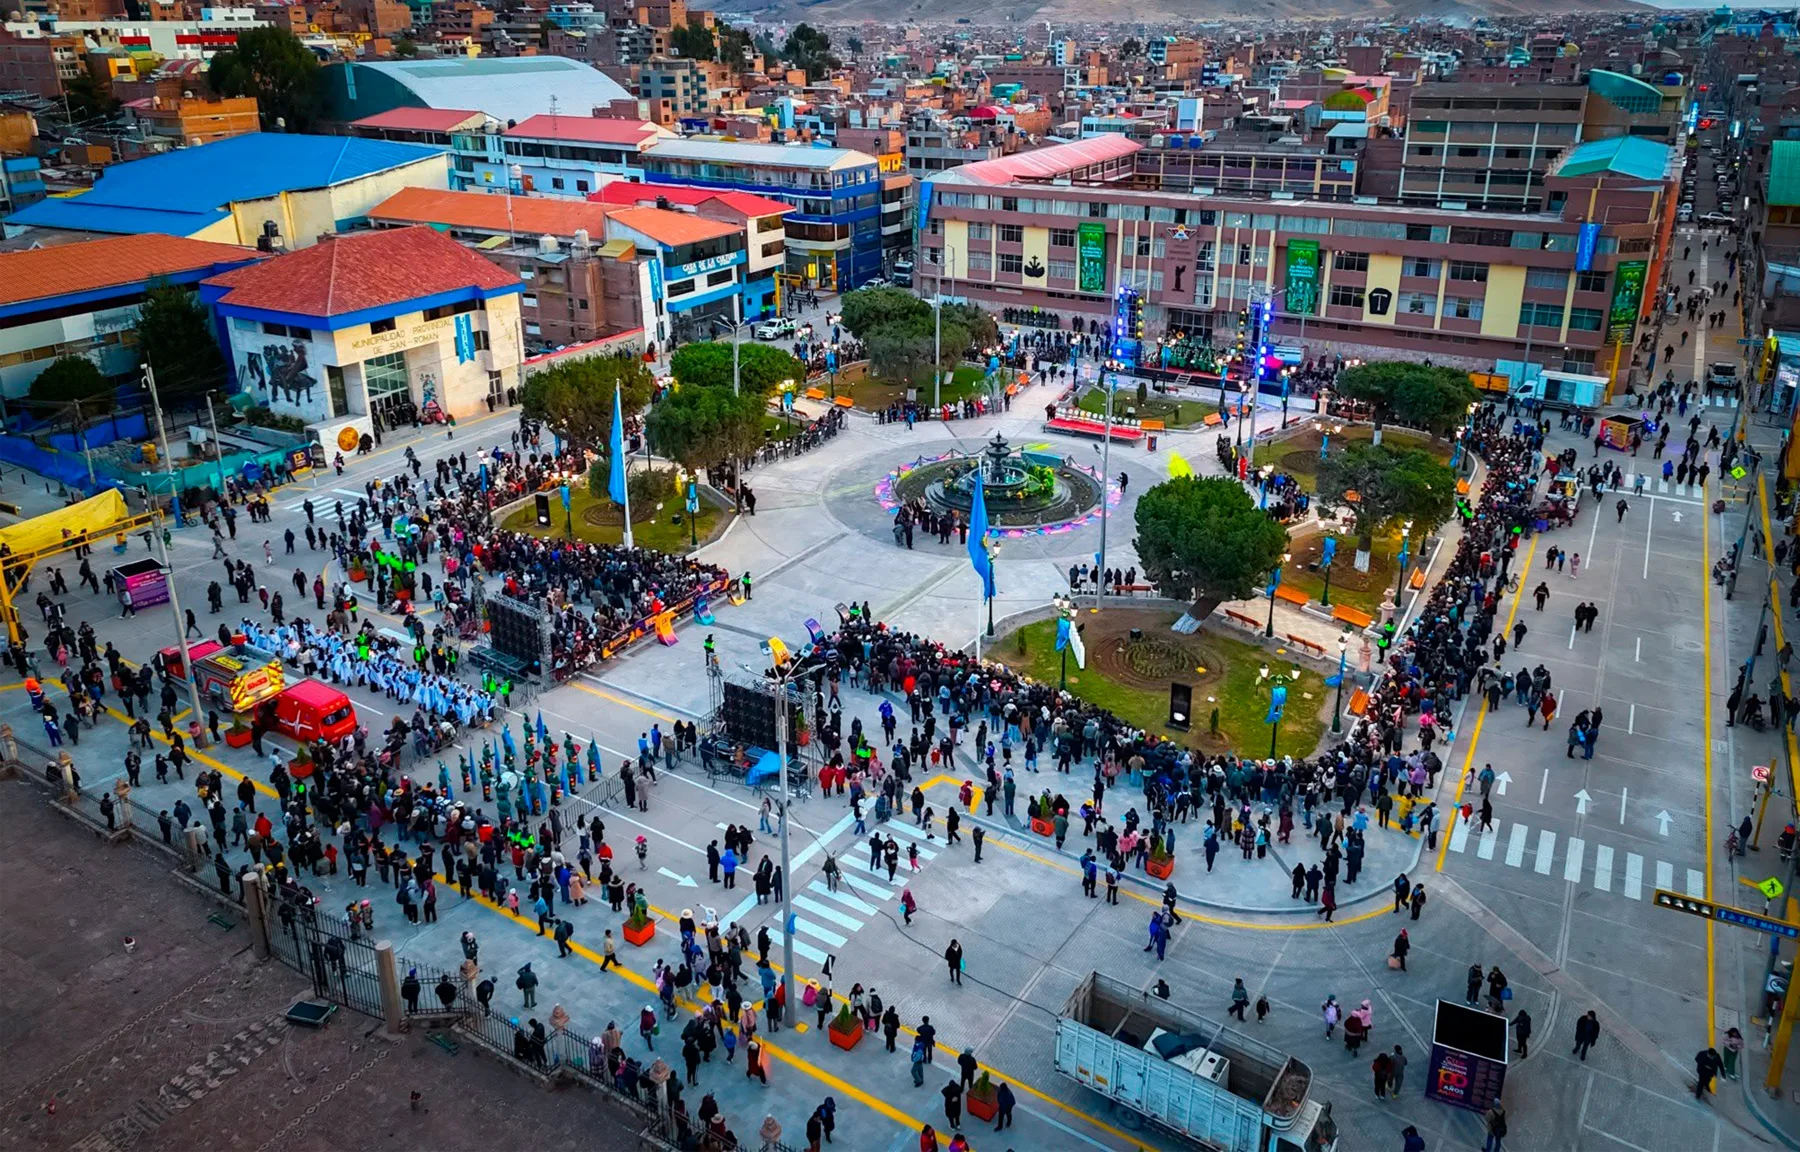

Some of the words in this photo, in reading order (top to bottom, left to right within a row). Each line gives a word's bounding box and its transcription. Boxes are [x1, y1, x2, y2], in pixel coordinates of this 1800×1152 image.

[682, 260, 696, 272] CASA
[716, 252, 738, 264] CULTURA
[352, 328, 405, 350] MUNICIPALIDAD
[412, 320, 453, 335] PROVINCIAL
[373, 345, 383, 355] DE
[1747, 917, 1757, 926] DE
[1760, 921, 1784, 934] MAYO
[1443, 1084, 1464, 1096] AÑOS
